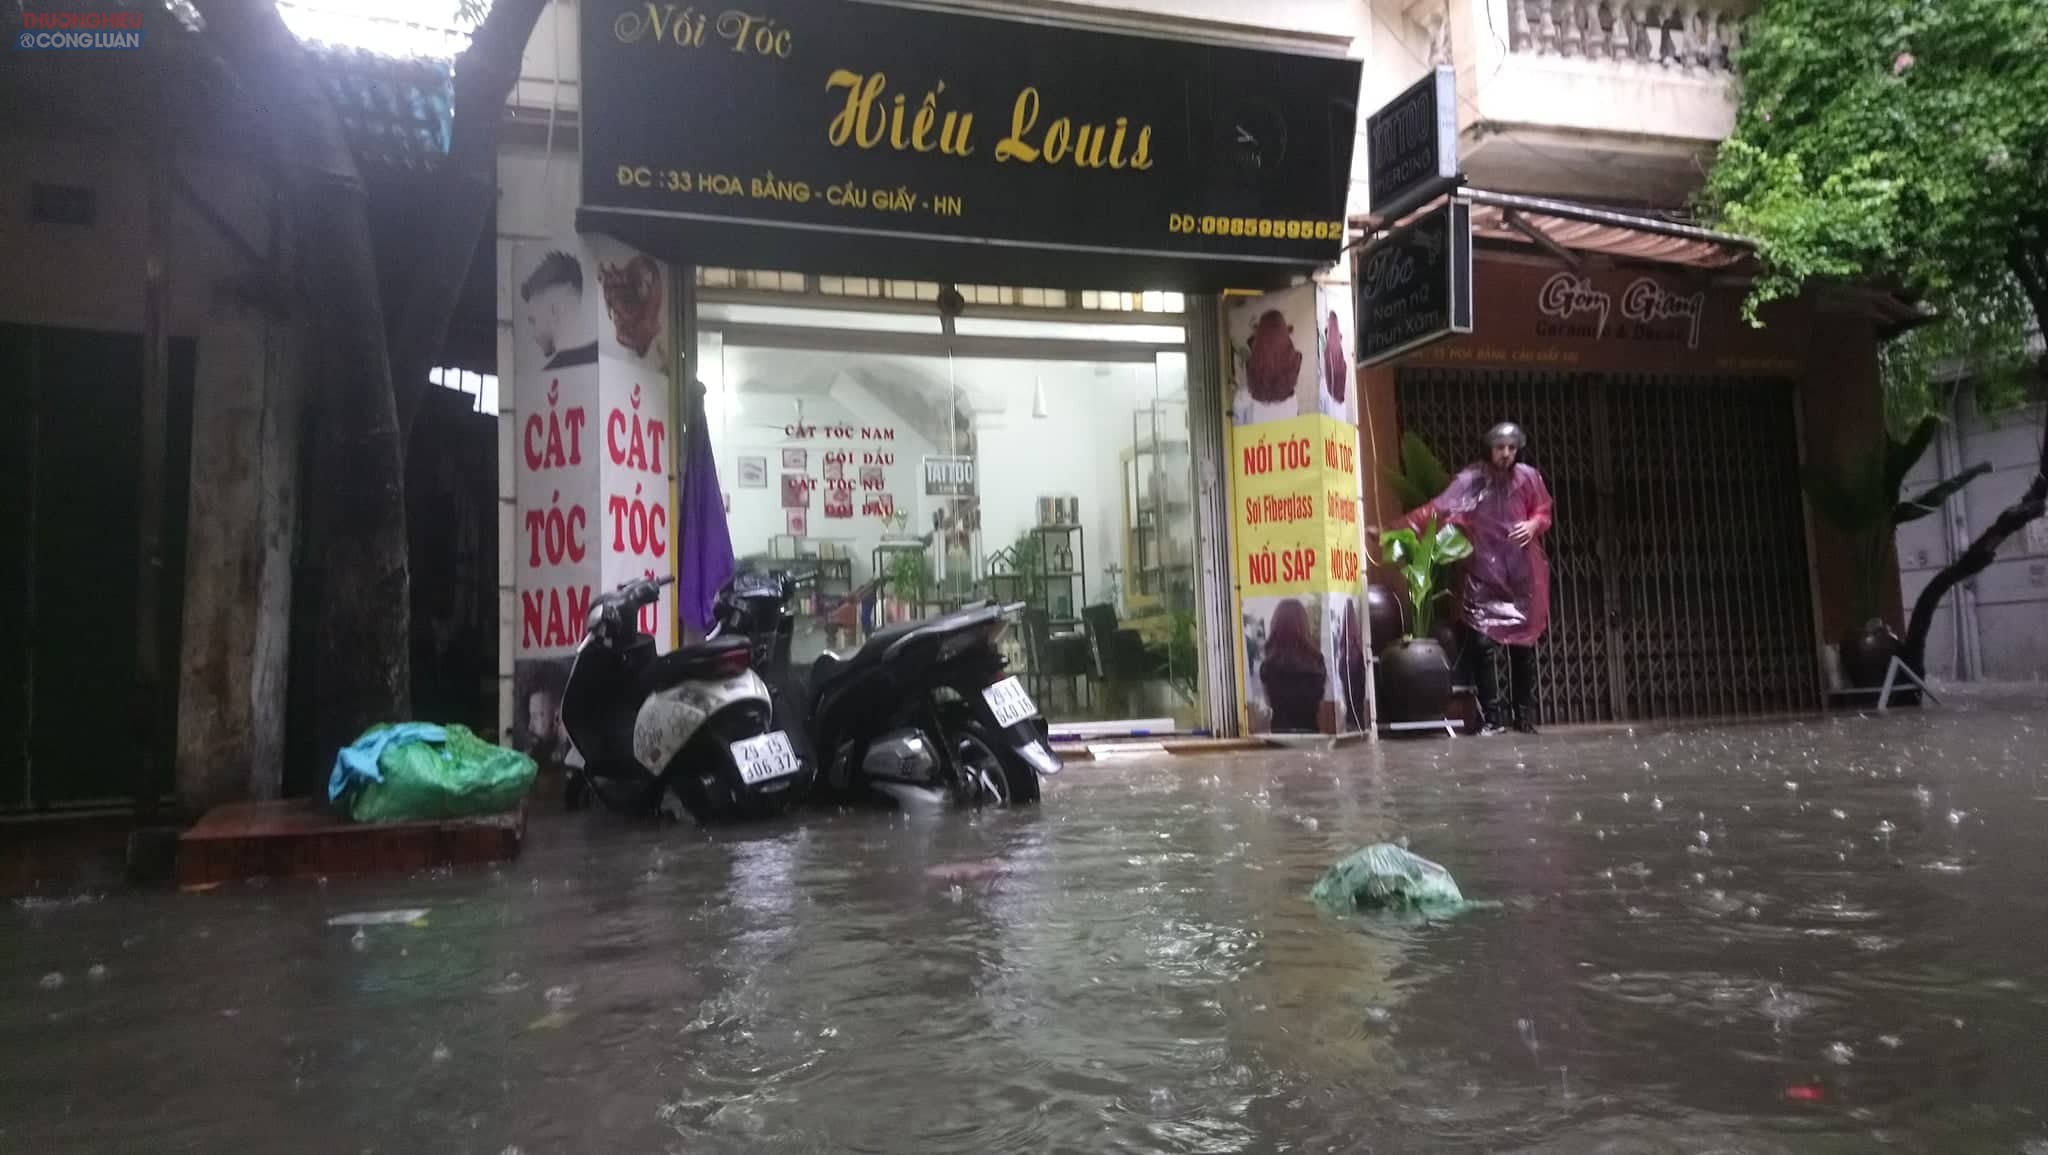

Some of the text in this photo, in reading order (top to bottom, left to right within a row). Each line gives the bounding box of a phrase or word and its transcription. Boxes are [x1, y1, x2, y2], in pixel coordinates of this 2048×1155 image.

[614, 1, 792, 58] Nối Tóc
[825, 69, 1153, 170] Hiếu Louis
[617, 165, 651, 187] ĐC
[699, 173, 744, 197] HOA
[934, 195, 962, 217] HN
[524, 378, 585, 471] CẮT
[607, 383, 665, 474] CẮT
[861, 427, 895, 440] NAM
[1243, 433, 1311, 476] NỐI TÓC
[526, 490, 586, 568] TÓC
[608, 482, 666, 558] TÓC
[1264, 493, 1313, 525] Fiberglass
[1249, 541, 1316, 585] NỐI SÁP
[522, 585, 591, 649] NAM
